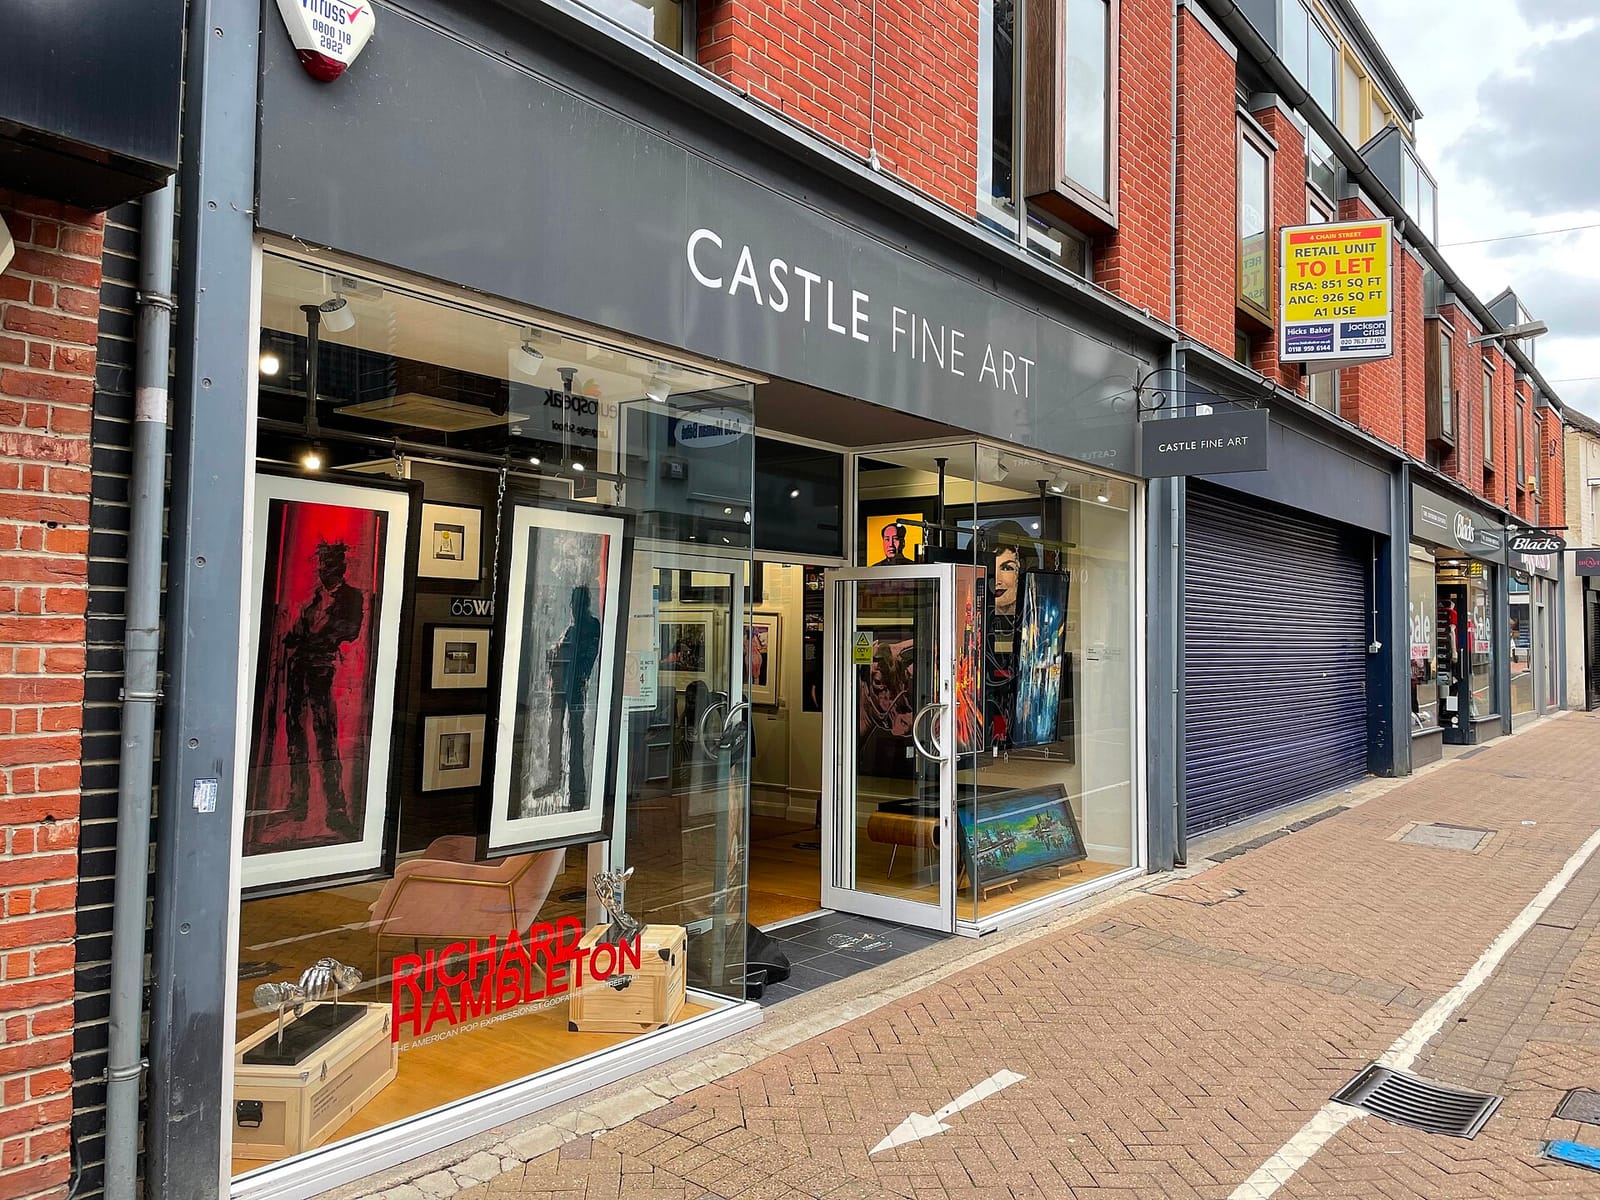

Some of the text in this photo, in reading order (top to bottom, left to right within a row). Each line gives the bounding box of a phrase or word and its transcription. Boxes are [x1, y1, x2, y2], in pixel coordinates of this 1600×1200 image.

[312, 19, 351, 45] 0800 118
[320, 35, 343, 55] 2822
[1338, 231, 1361, 239] STREET
[1295, 243, 1376, 258] RETAIL UNIT
[1297, 257, 1374, 278] TO LET
[1290, 277, 1382, 291] RSA: 851 SQ FT
[1288, 291, 1382, 305] ANC: 926 SQ FT
[686, 228, 1035, 398] CASTLE FINE ART
[1314, 306, 1356, 317] A1 USE
[1309, 326, 1331, 334] Baker
[1362, 328, 1384, 336] criss
[1158, 436, 1248, 453] CASTLE FINE ART
[1512, 537, 1561, 550] Blacks
[392, 915, 583, 993] RICHARD
[391, 933, 642, 1043] HAMBLETON
[412, 1027, 459, 1049] AMERICAN
[460, 1022, 479, 1033] POP
[480, 1002, 544, 1028] EXPRESSIONIST
